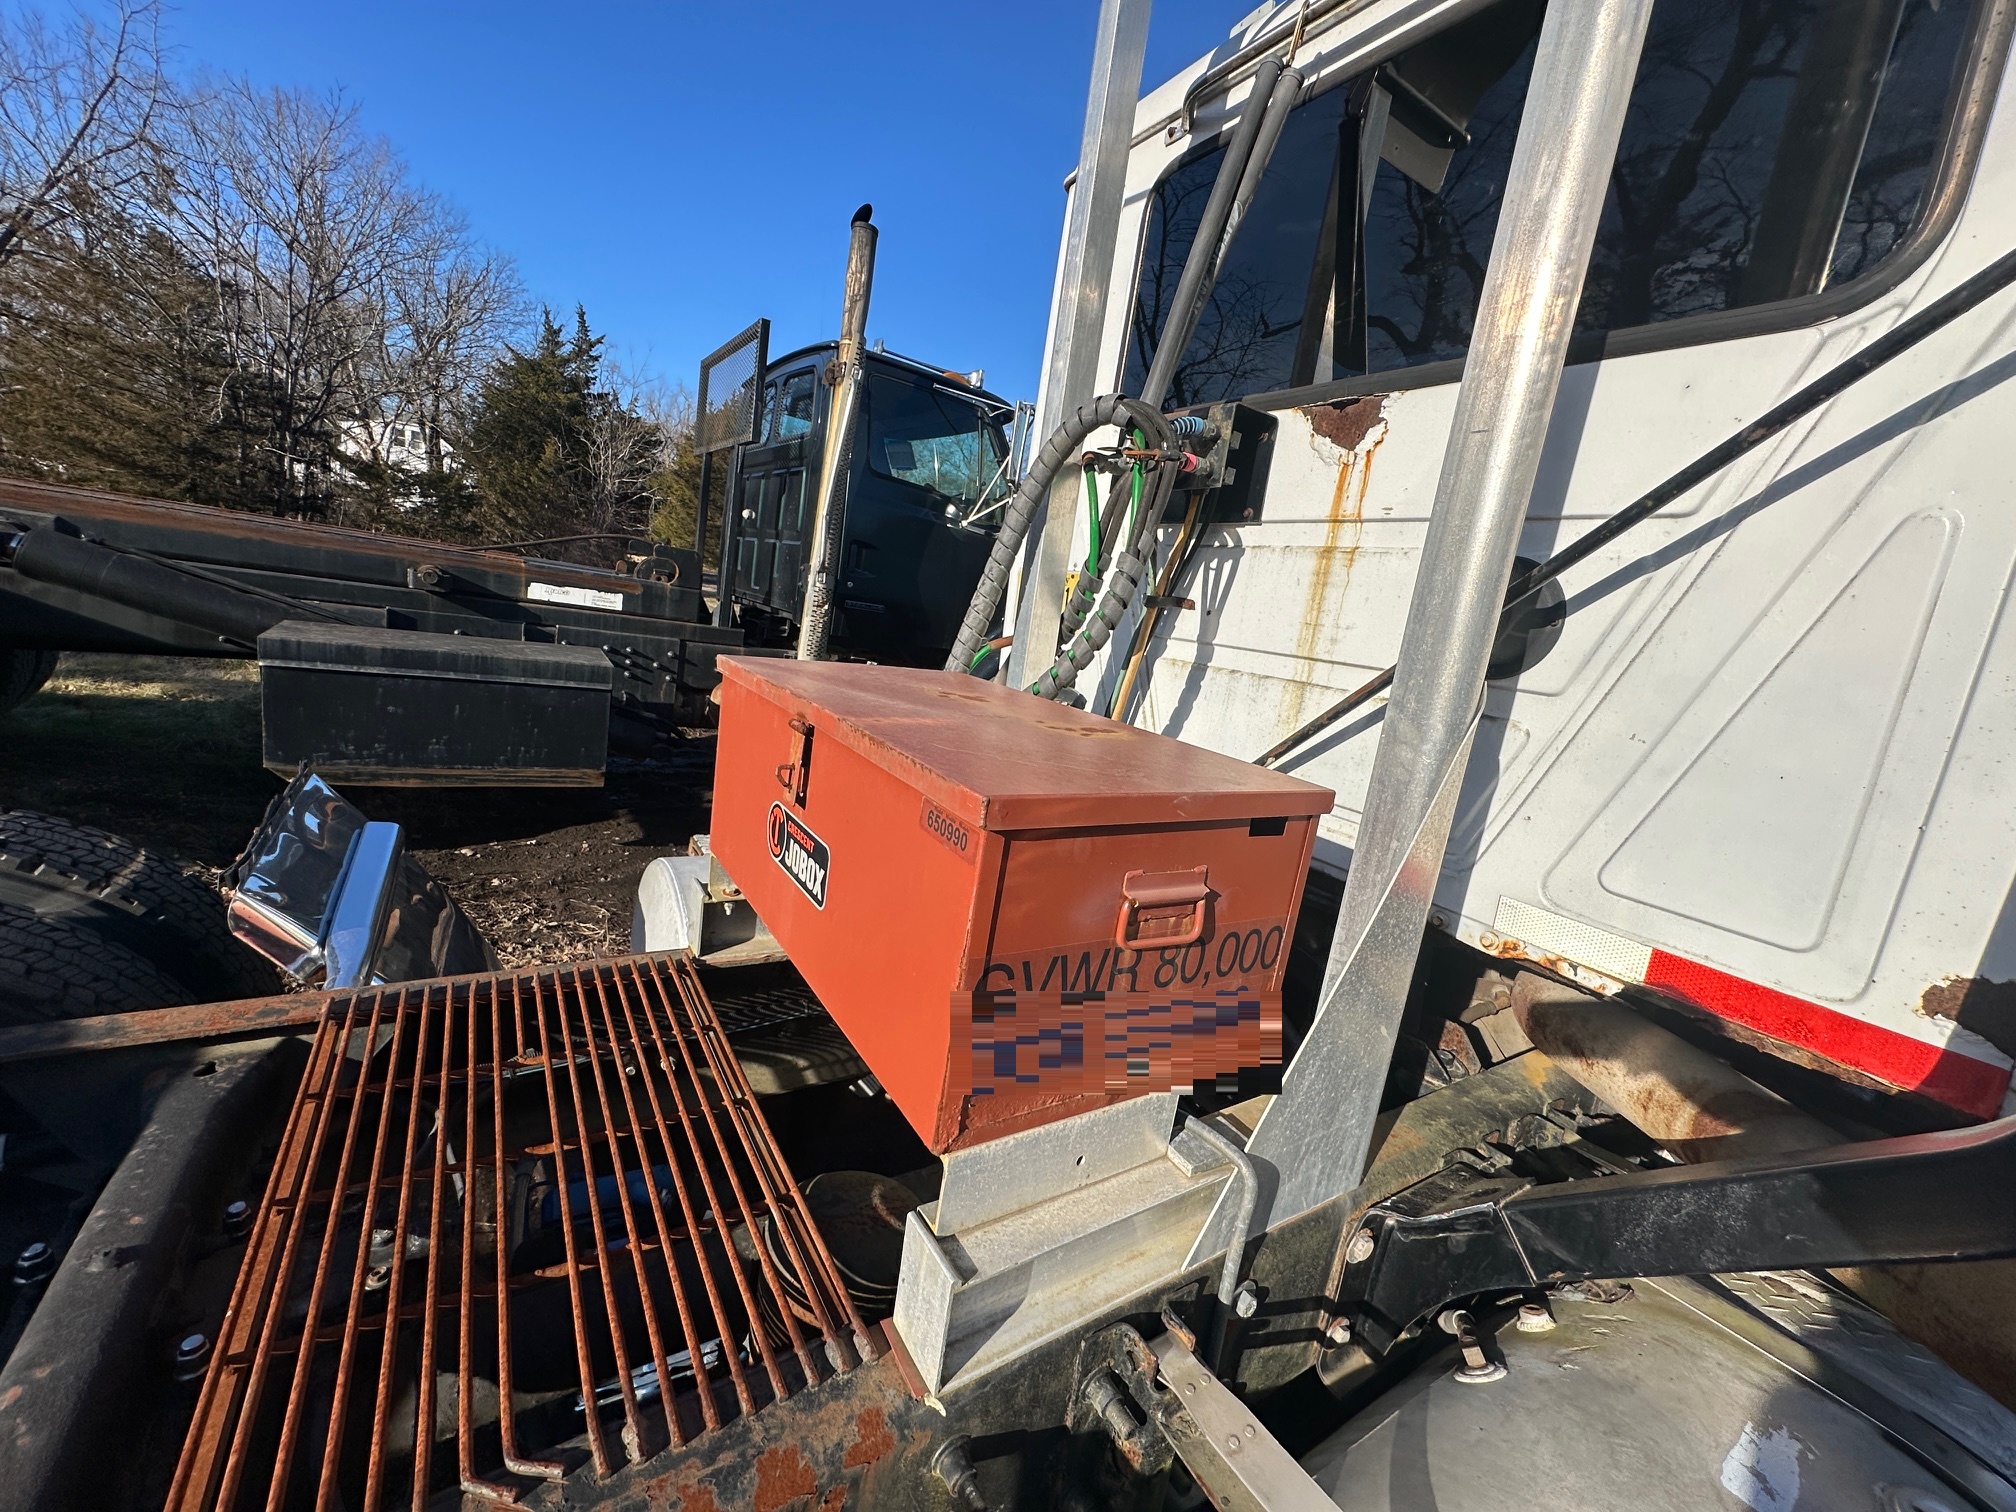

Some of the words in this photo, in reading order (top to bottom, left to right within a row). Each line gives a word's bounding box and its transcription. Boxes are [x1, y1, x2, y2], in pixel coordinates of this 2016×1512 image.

[788, 820, 815, 853] CRESCENT
[927, 809, 968, 852] 650990
[785, 838, 825, 901] JOBOX
[1154, 925, 1283, 988] 80,000
